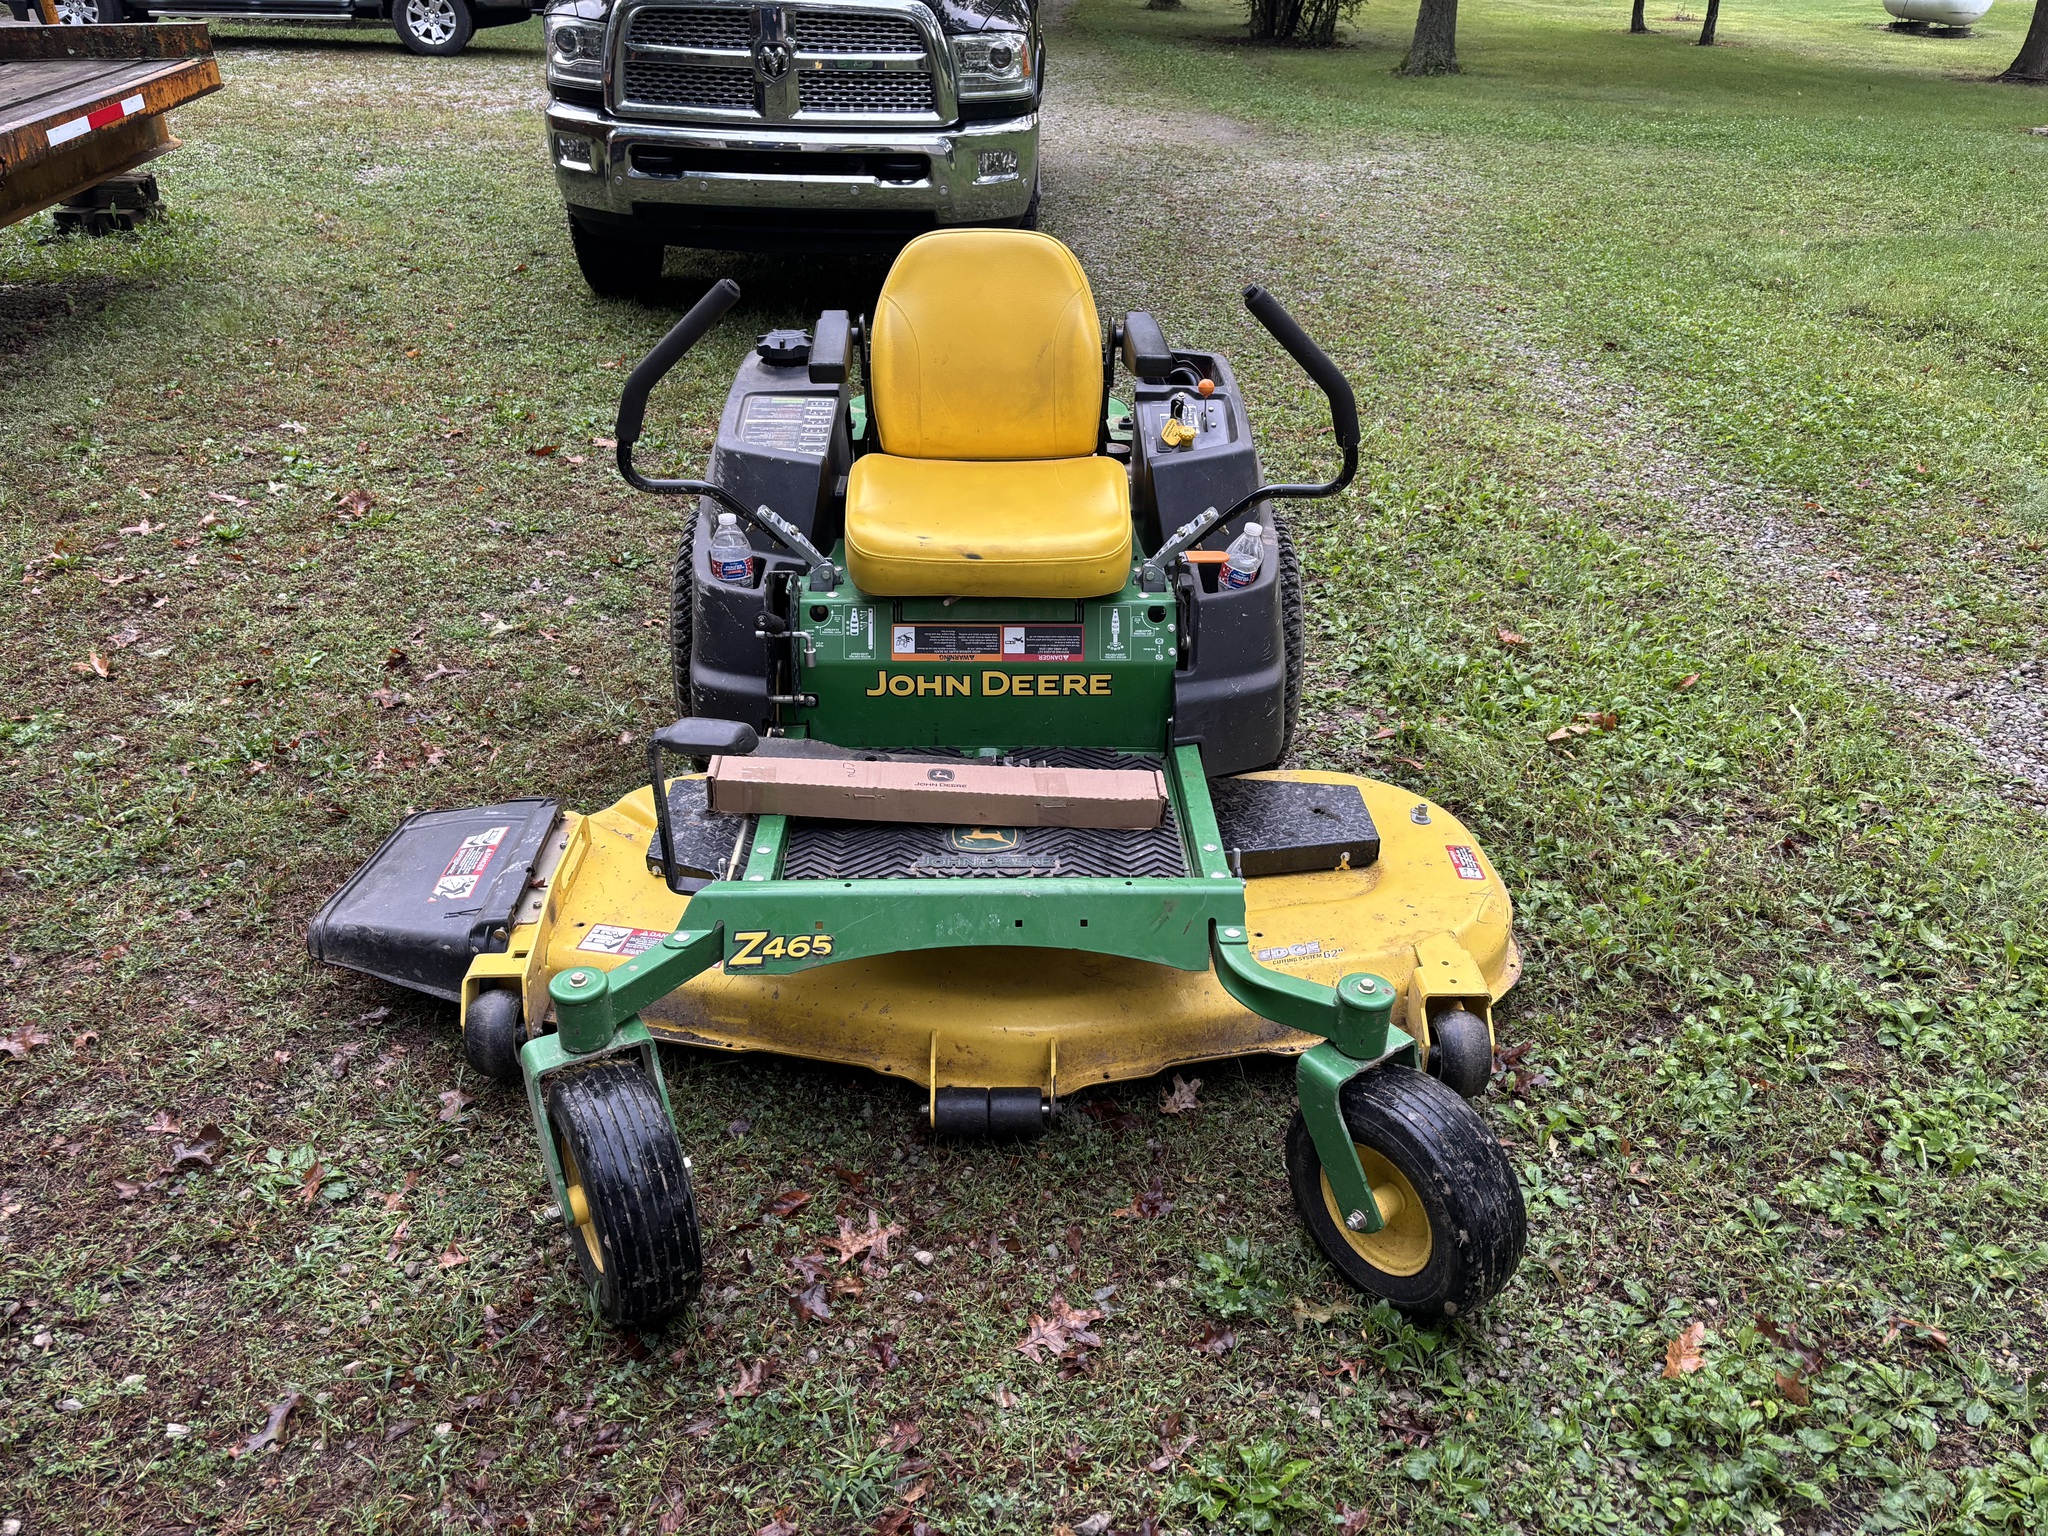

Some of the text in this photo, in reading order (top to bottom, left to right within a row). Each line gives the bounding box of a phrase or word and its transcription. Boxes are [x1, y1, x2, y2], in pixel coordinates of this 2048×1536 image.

[865, 669, 1113, 697] JOHN DEERE
[917, 855, 1055, 868] JOHN DEERE
[726, 930, 834, 968] Z465
[1258, 941, 1321, 962] EDGE
[1272, 957, 1298, 965] CUTTING
[1299, 953, 1322, 962] SYSTEM
